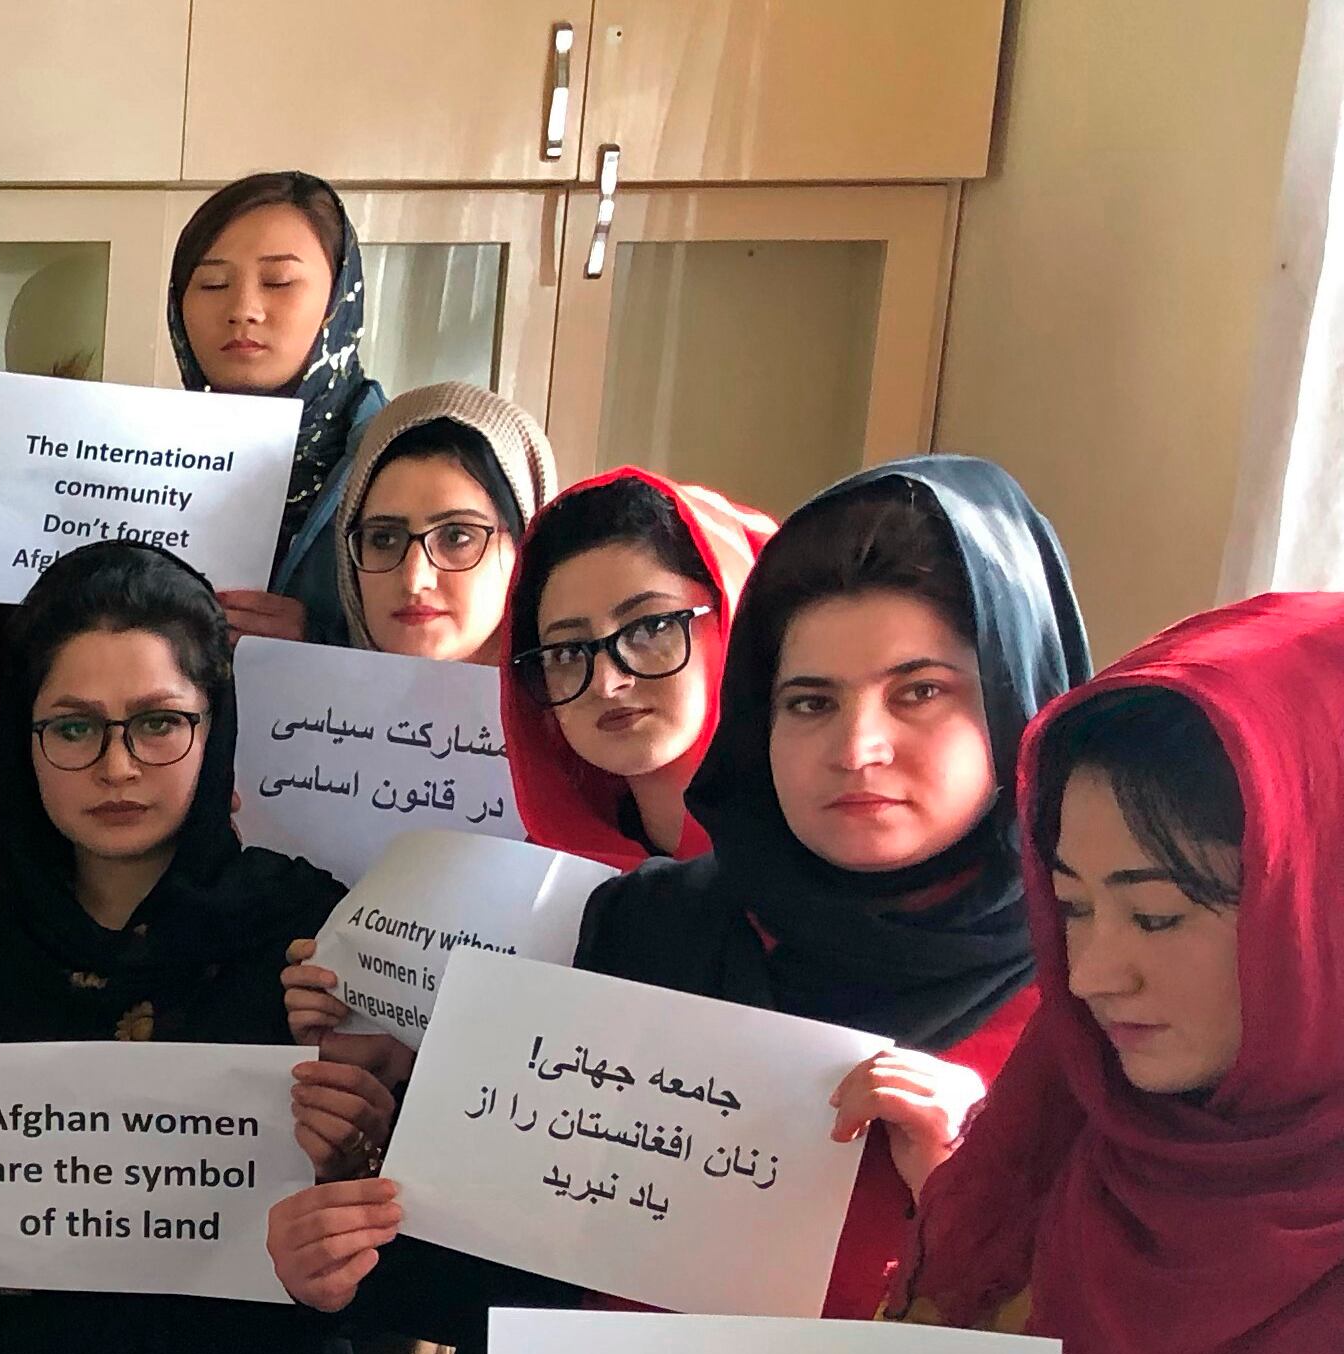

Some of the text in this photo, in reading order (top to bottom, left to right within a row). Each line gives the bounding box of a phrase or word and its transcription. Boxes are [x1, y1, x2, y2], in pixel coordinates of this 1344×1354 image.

[26, 434, 234, 473] The International
[54, 479, 193, 512] community
[116, 521, 191, 549] forget
[270, 706, 375, 745] سیاسی
[258, 764, 504, 824] در قانون اساسی
[347, 906, 365, 927] A
[364, 908, 437, 951] Country
[357, 951, 436, 992] women is
[342, 980, 430, 1031] languagele
[528, 1035, 742, 1118] جامعه جهانی!
[121, 1112, 259, 1137] women
[464, 1086, 779, 1190] زنان افغانستان را از
[53, 1155, 113, 1185] the
[124, 1158, 255, 1193] symbol
[542, 1165, 669, 1222] یاد نبرید
[20, 1207, 220, 1241] of this land
